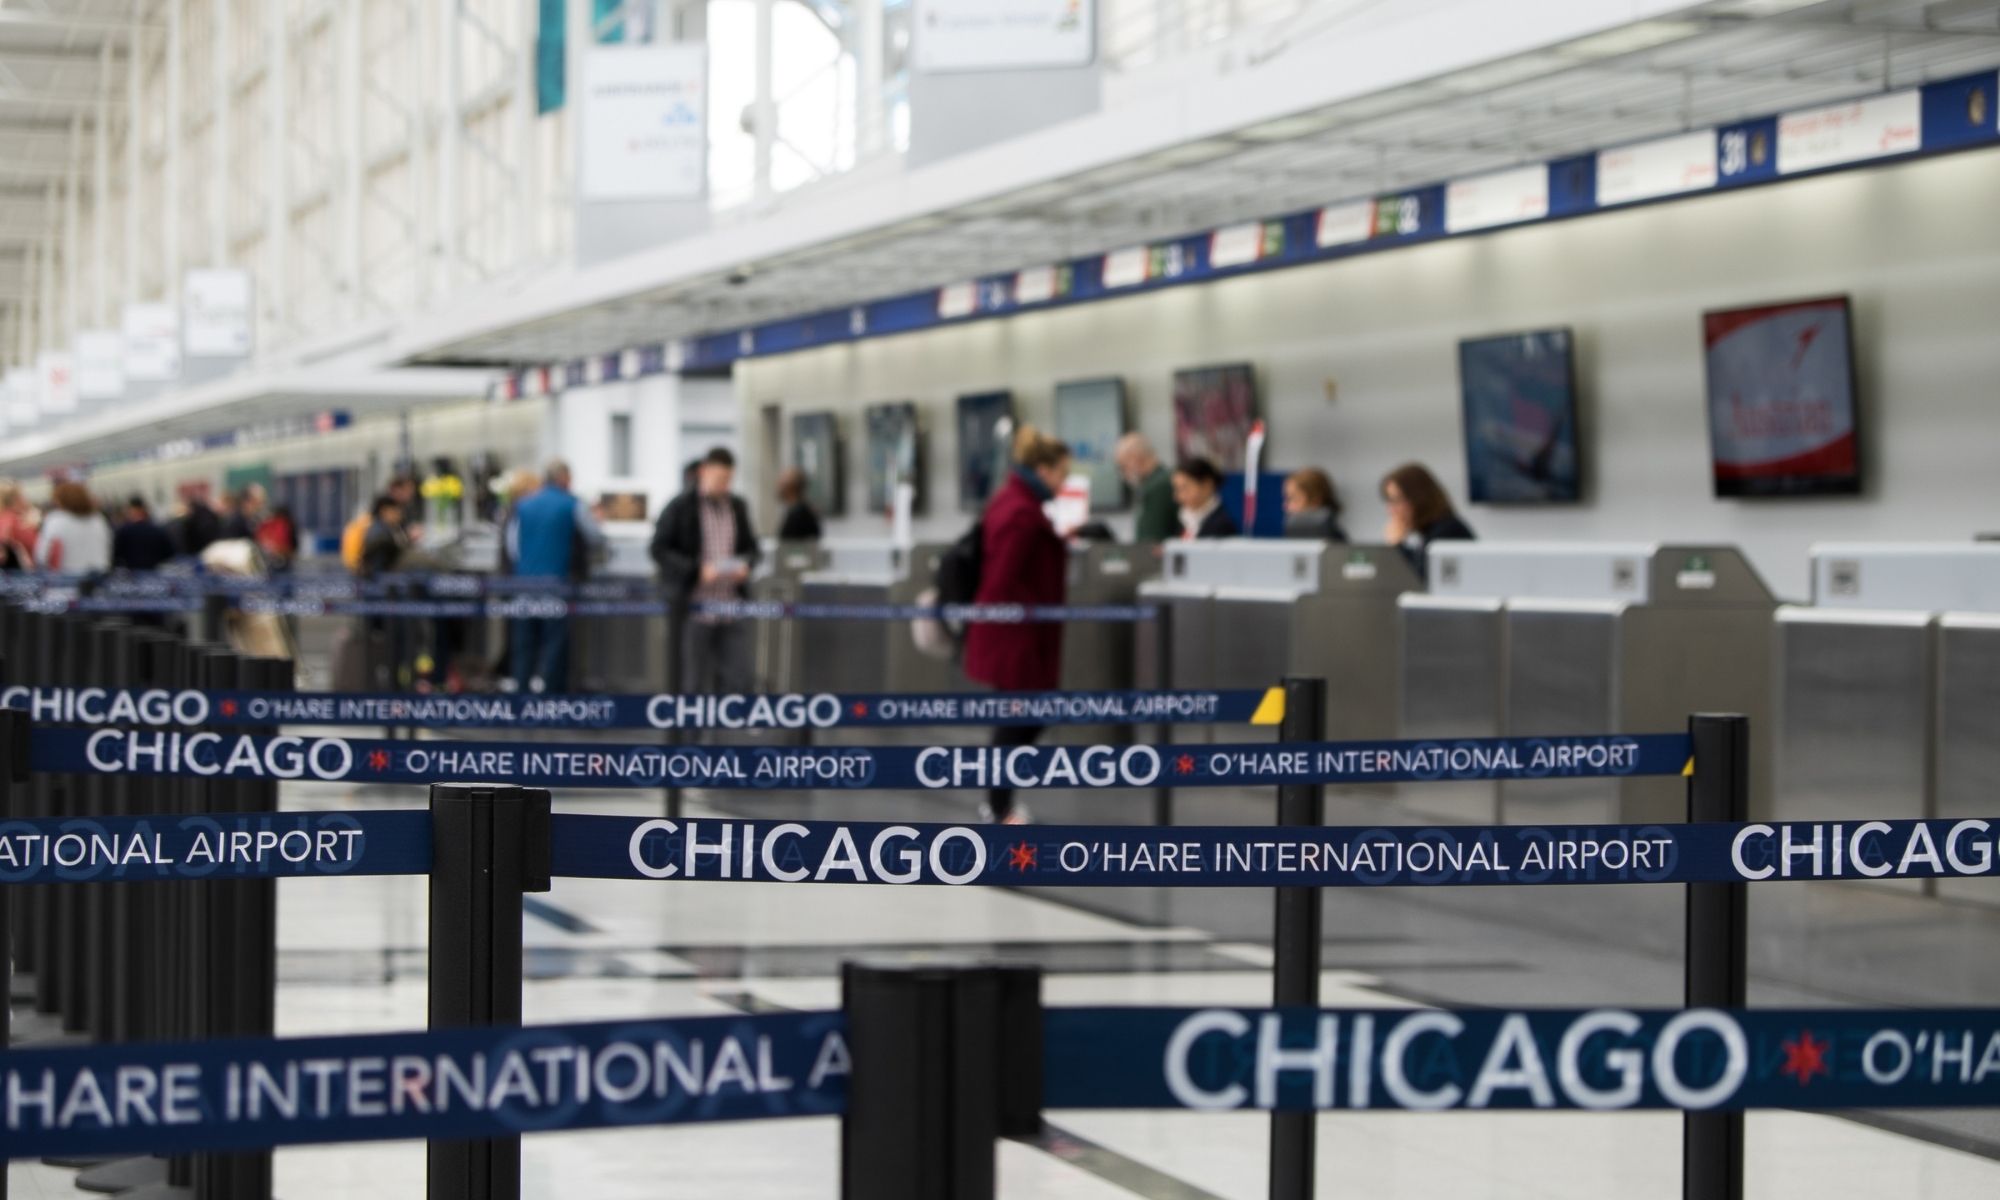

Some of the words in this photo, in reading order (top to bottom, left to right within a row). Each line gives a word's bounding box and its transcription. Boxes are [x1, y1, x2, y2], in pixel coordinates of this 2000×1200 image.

[1720, 129, 1747, 176] 31
[1, 685, 210, 726] CHICAGO
[248, 697, 335, 719] O'HARE
[336, 698, 516, 721] INTERNATIONAL
[521, 699, 615, 721] AIRPORT
[646, 692, 843, 730] CHICAGO
[878, 699, 957, 719] O'HARE
[963, 696, 1128, 719] INTERNATIONAL
[1132, 694, 1219, 716] AIRPORT
[86, 728, 354, 780] CHICAGO
[405, 749, 514, 776] O'HARE
[522, 752, 747, 779] INTERNATIONAL
[754, 755, 872, 779] AIRPORT
[914, 744, 1162, 789] CHICAGO
[1209, 751, 1309, 776] O'HARE
[1317, 746, 1524, 775] INTERNATIONAL
[1529, 743, 1640, 769] AIRPORT
[0, 832, 174, 867] ATIONAL
[185, 829, 363, 864] AIRPORT
[628, 818, 988, 885] CHICAGO
[1059, 841, 1202, 873] O'HARE
[1214, 841, 1510, 872] INTERNATIONAL
[1520, 838, 1673, 870] AIRPORT
[1731, 819, 2000, 880] CHICAG
[226, 1033, 794, 1120] INTERNATIONAL
[1163, 1008, 1749, 1112] CHICAGO
[1861, 1029, 2000, 1085] O'HA
